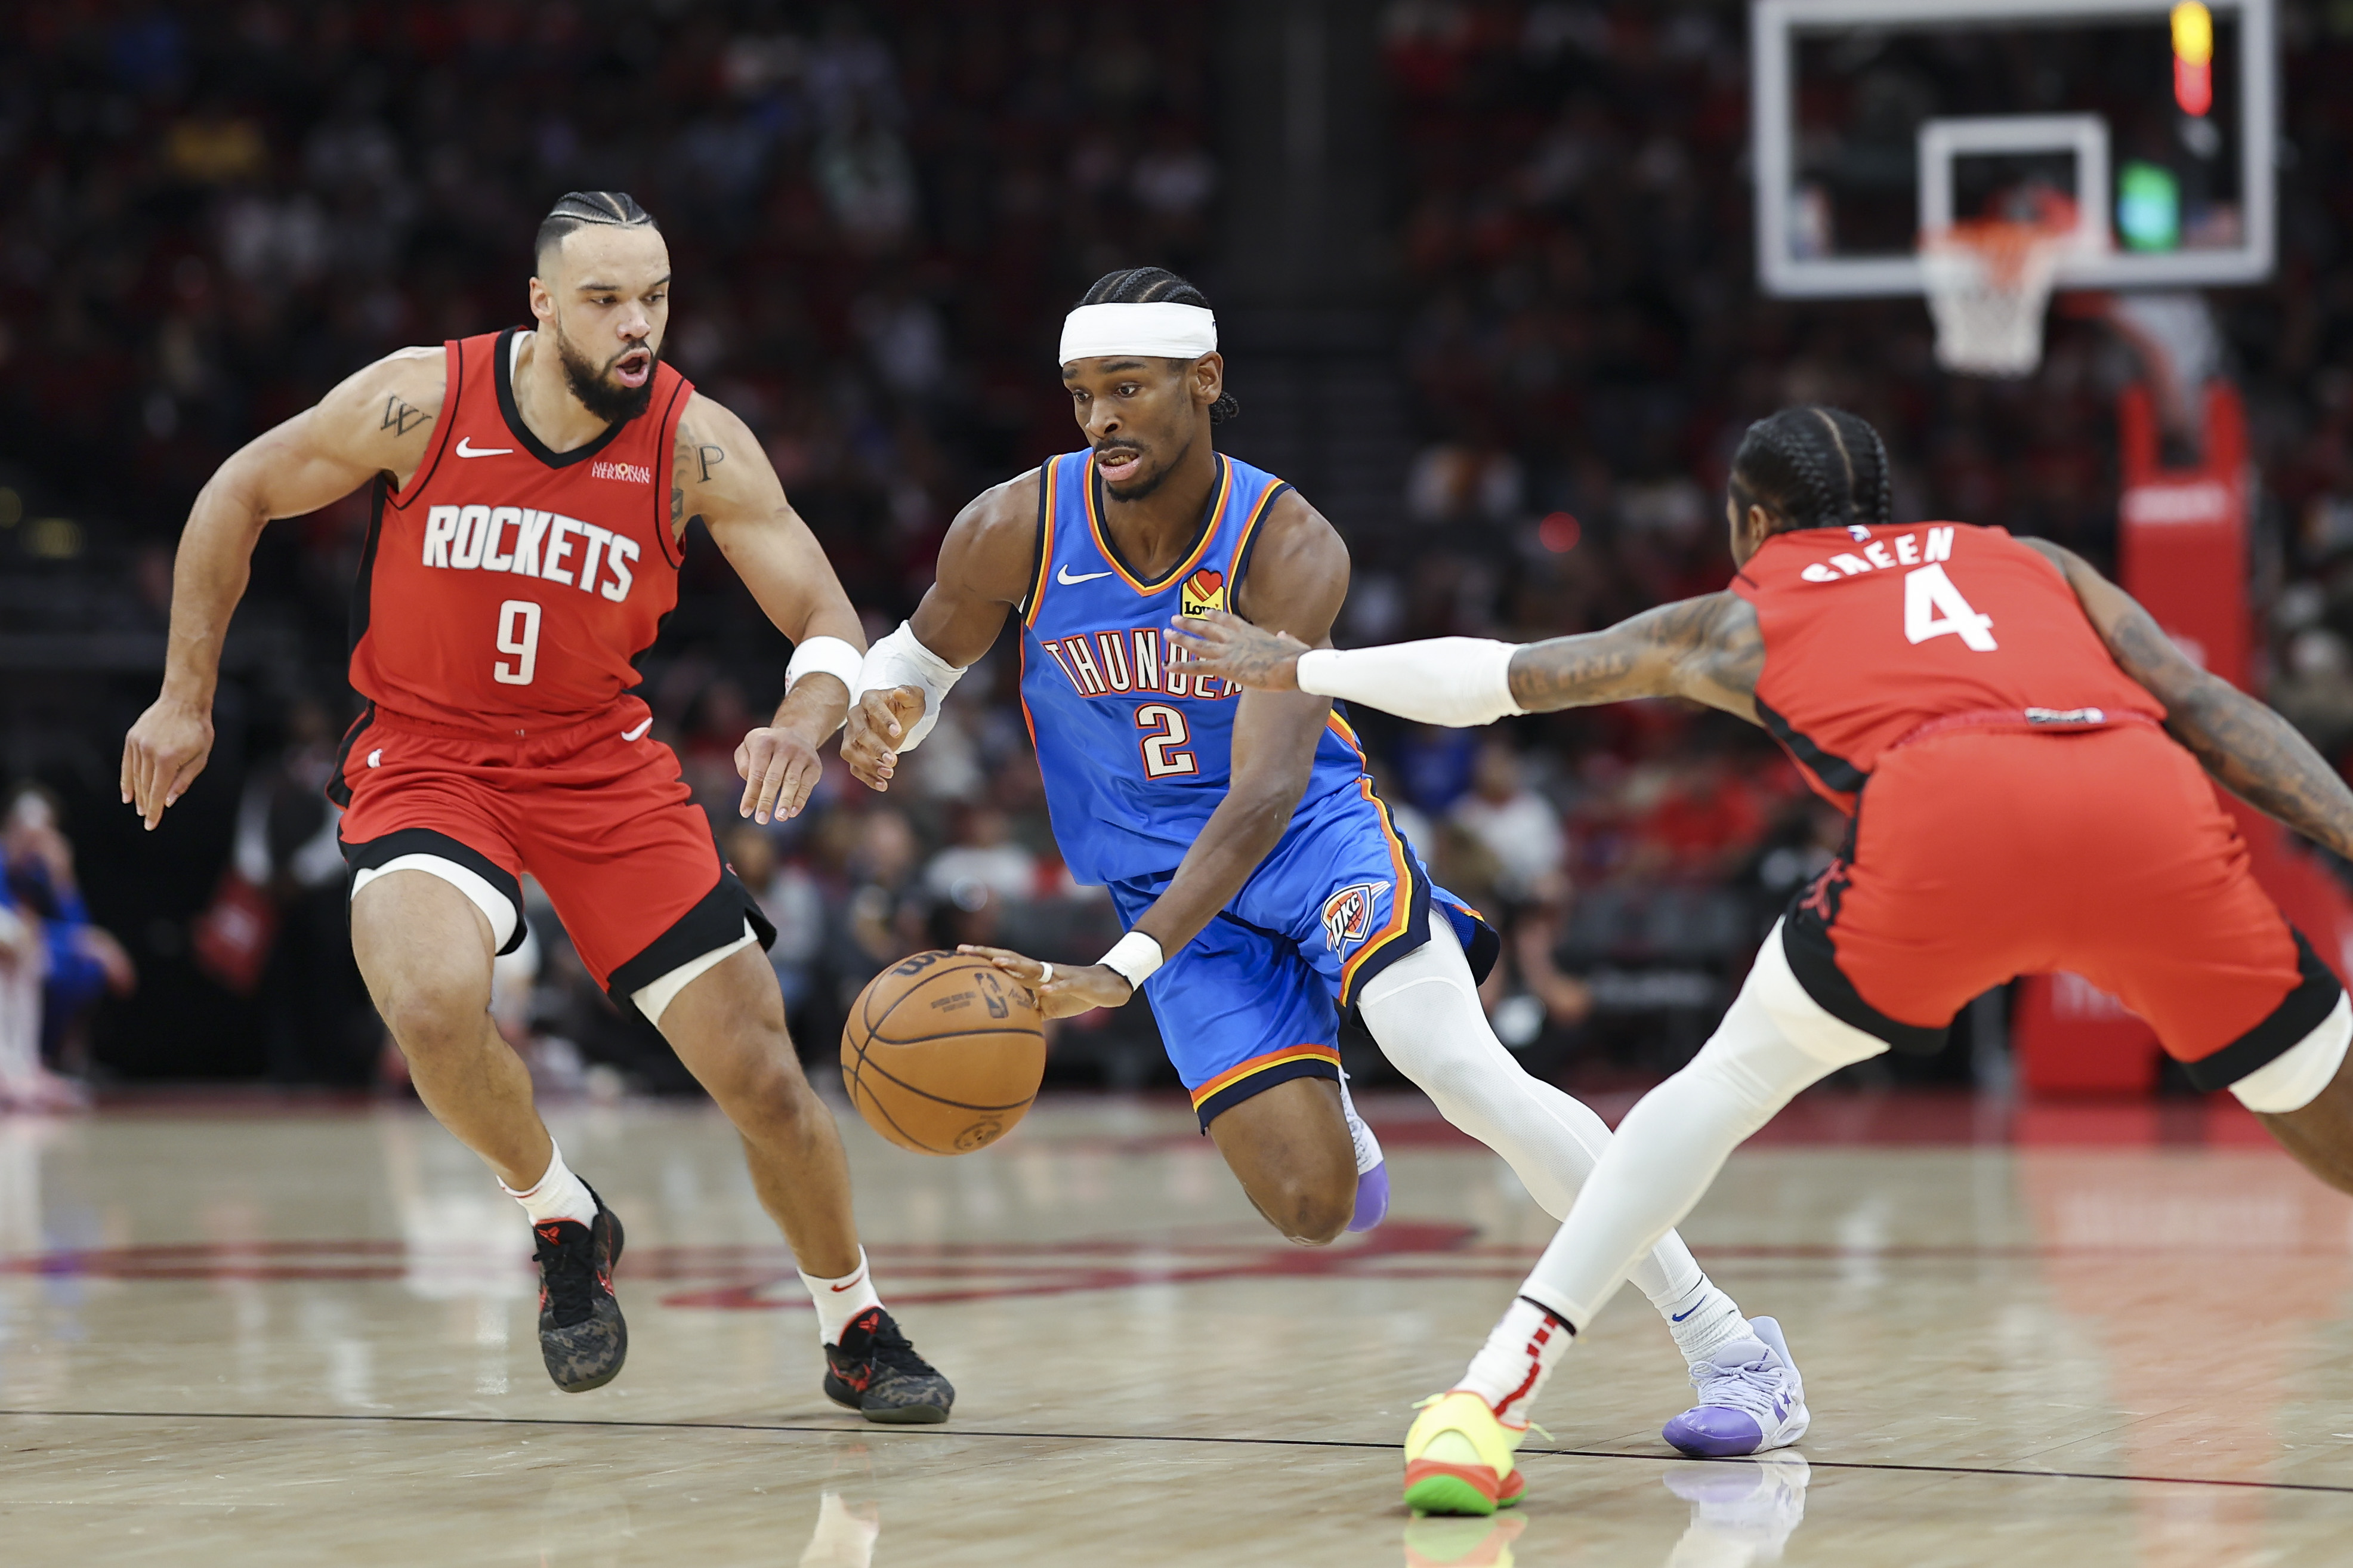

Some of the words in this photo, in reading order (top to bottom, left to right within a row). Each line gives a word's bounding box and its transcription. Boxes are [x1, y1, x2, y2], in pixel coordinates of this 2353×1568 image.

[591, 467, 650, 484] HERMANN
[592, 461, 650, 477] MEMORIAL
[422, 504, 640, 603] ROCKETS
[493, 599, 542, 686] 9
[1904, 562, 1999, 652] 4
[1134, 702, 1199, 782] 2
[1330, 893, 1361, 949] OKC
